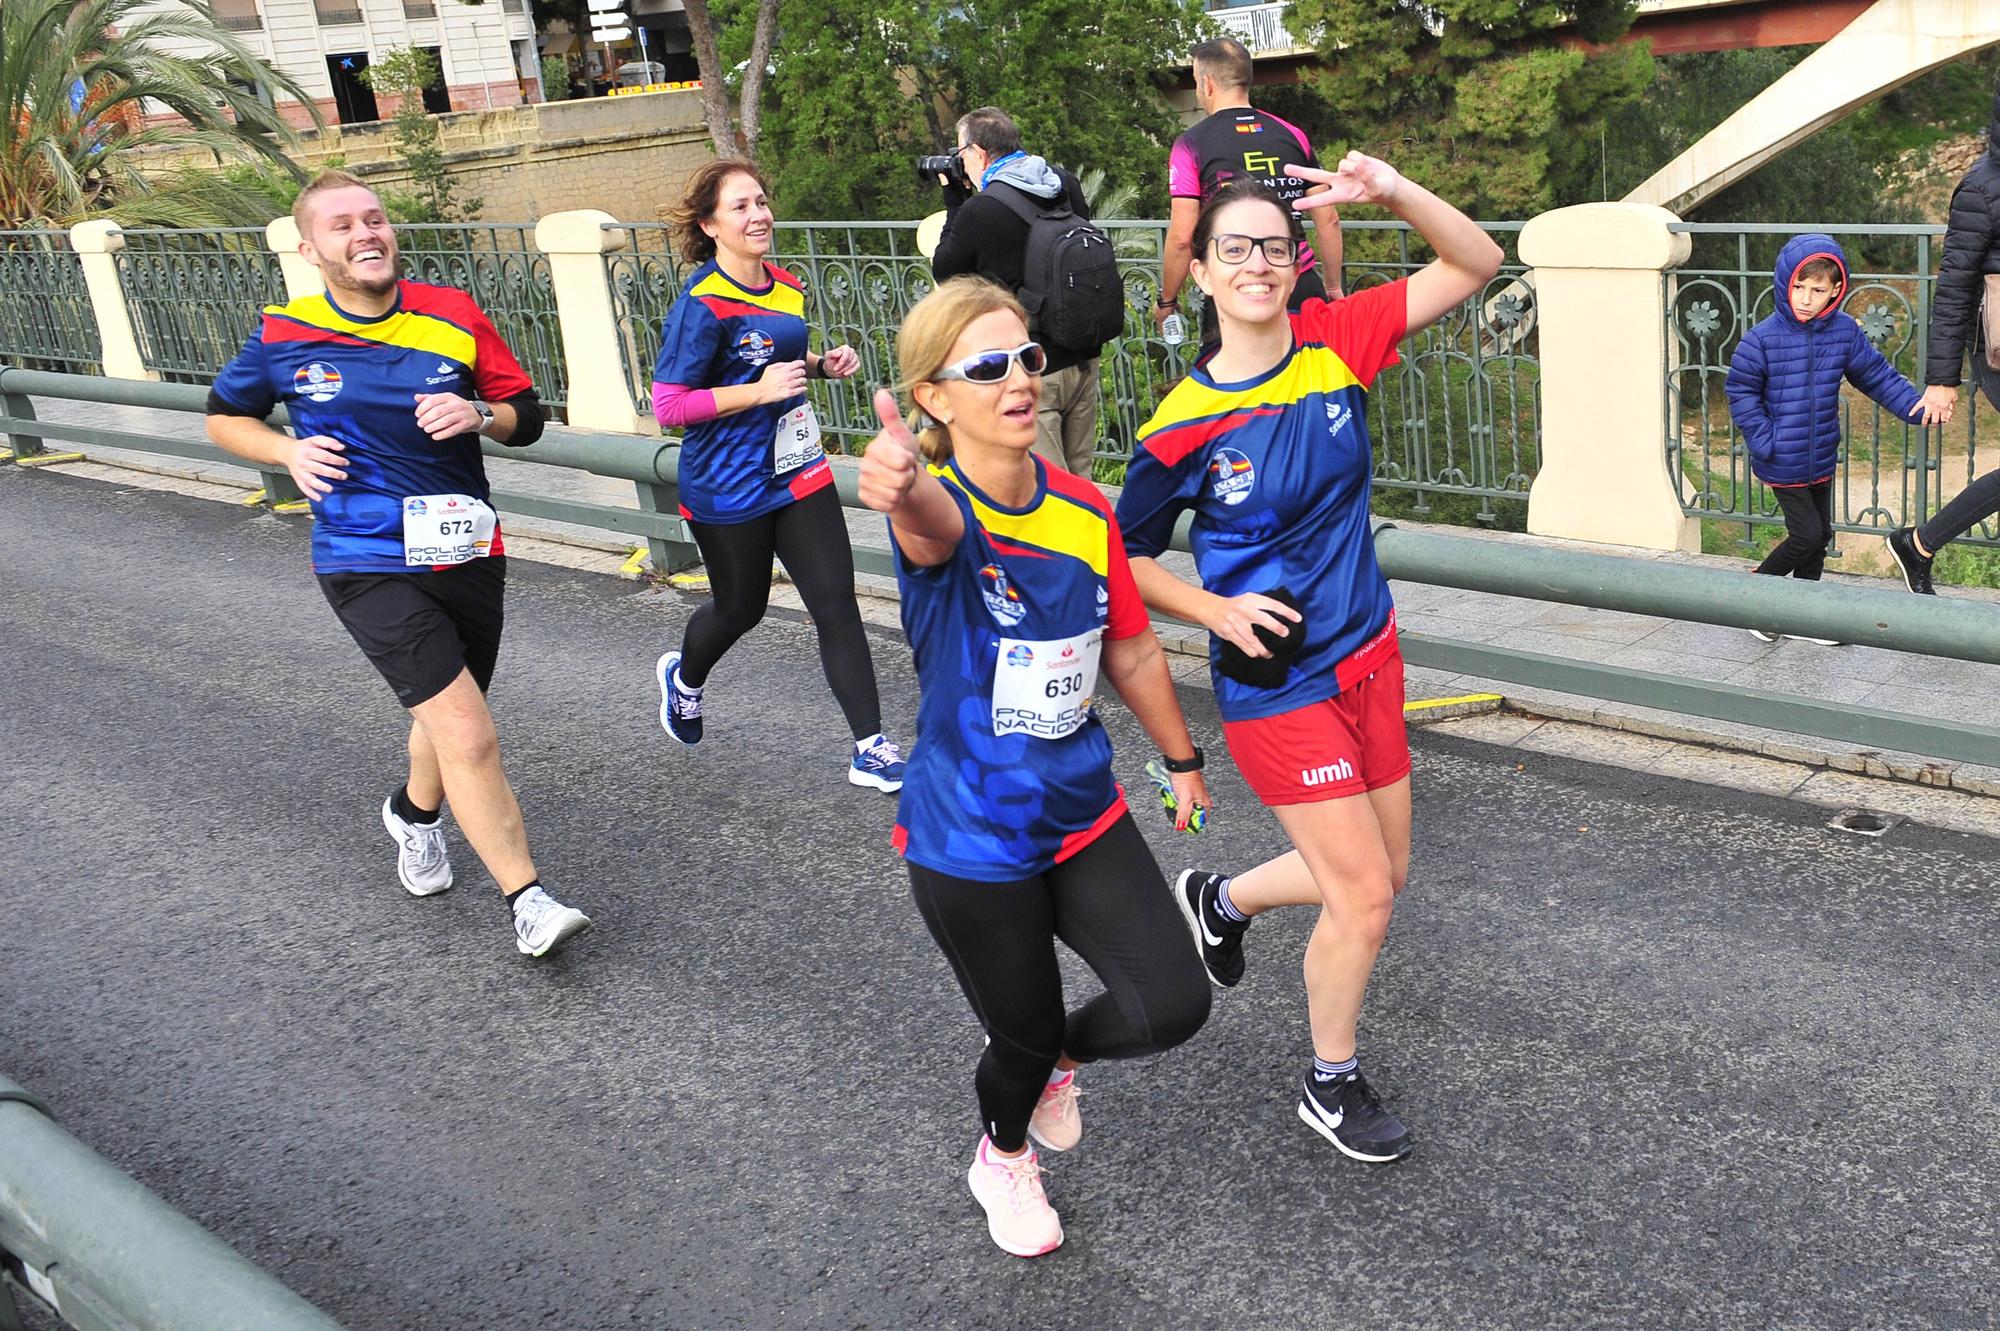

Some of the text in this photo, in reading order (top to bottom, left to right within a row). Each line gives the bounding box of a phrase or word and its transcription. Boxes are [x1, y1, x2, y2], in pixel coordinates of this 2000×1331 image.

[1243, 151, 1280, 176] ET
[440, 520, 473, 535] 672
[1045, 672, 1082, 698] 630
[1302, 758, 1354, 787] umh
